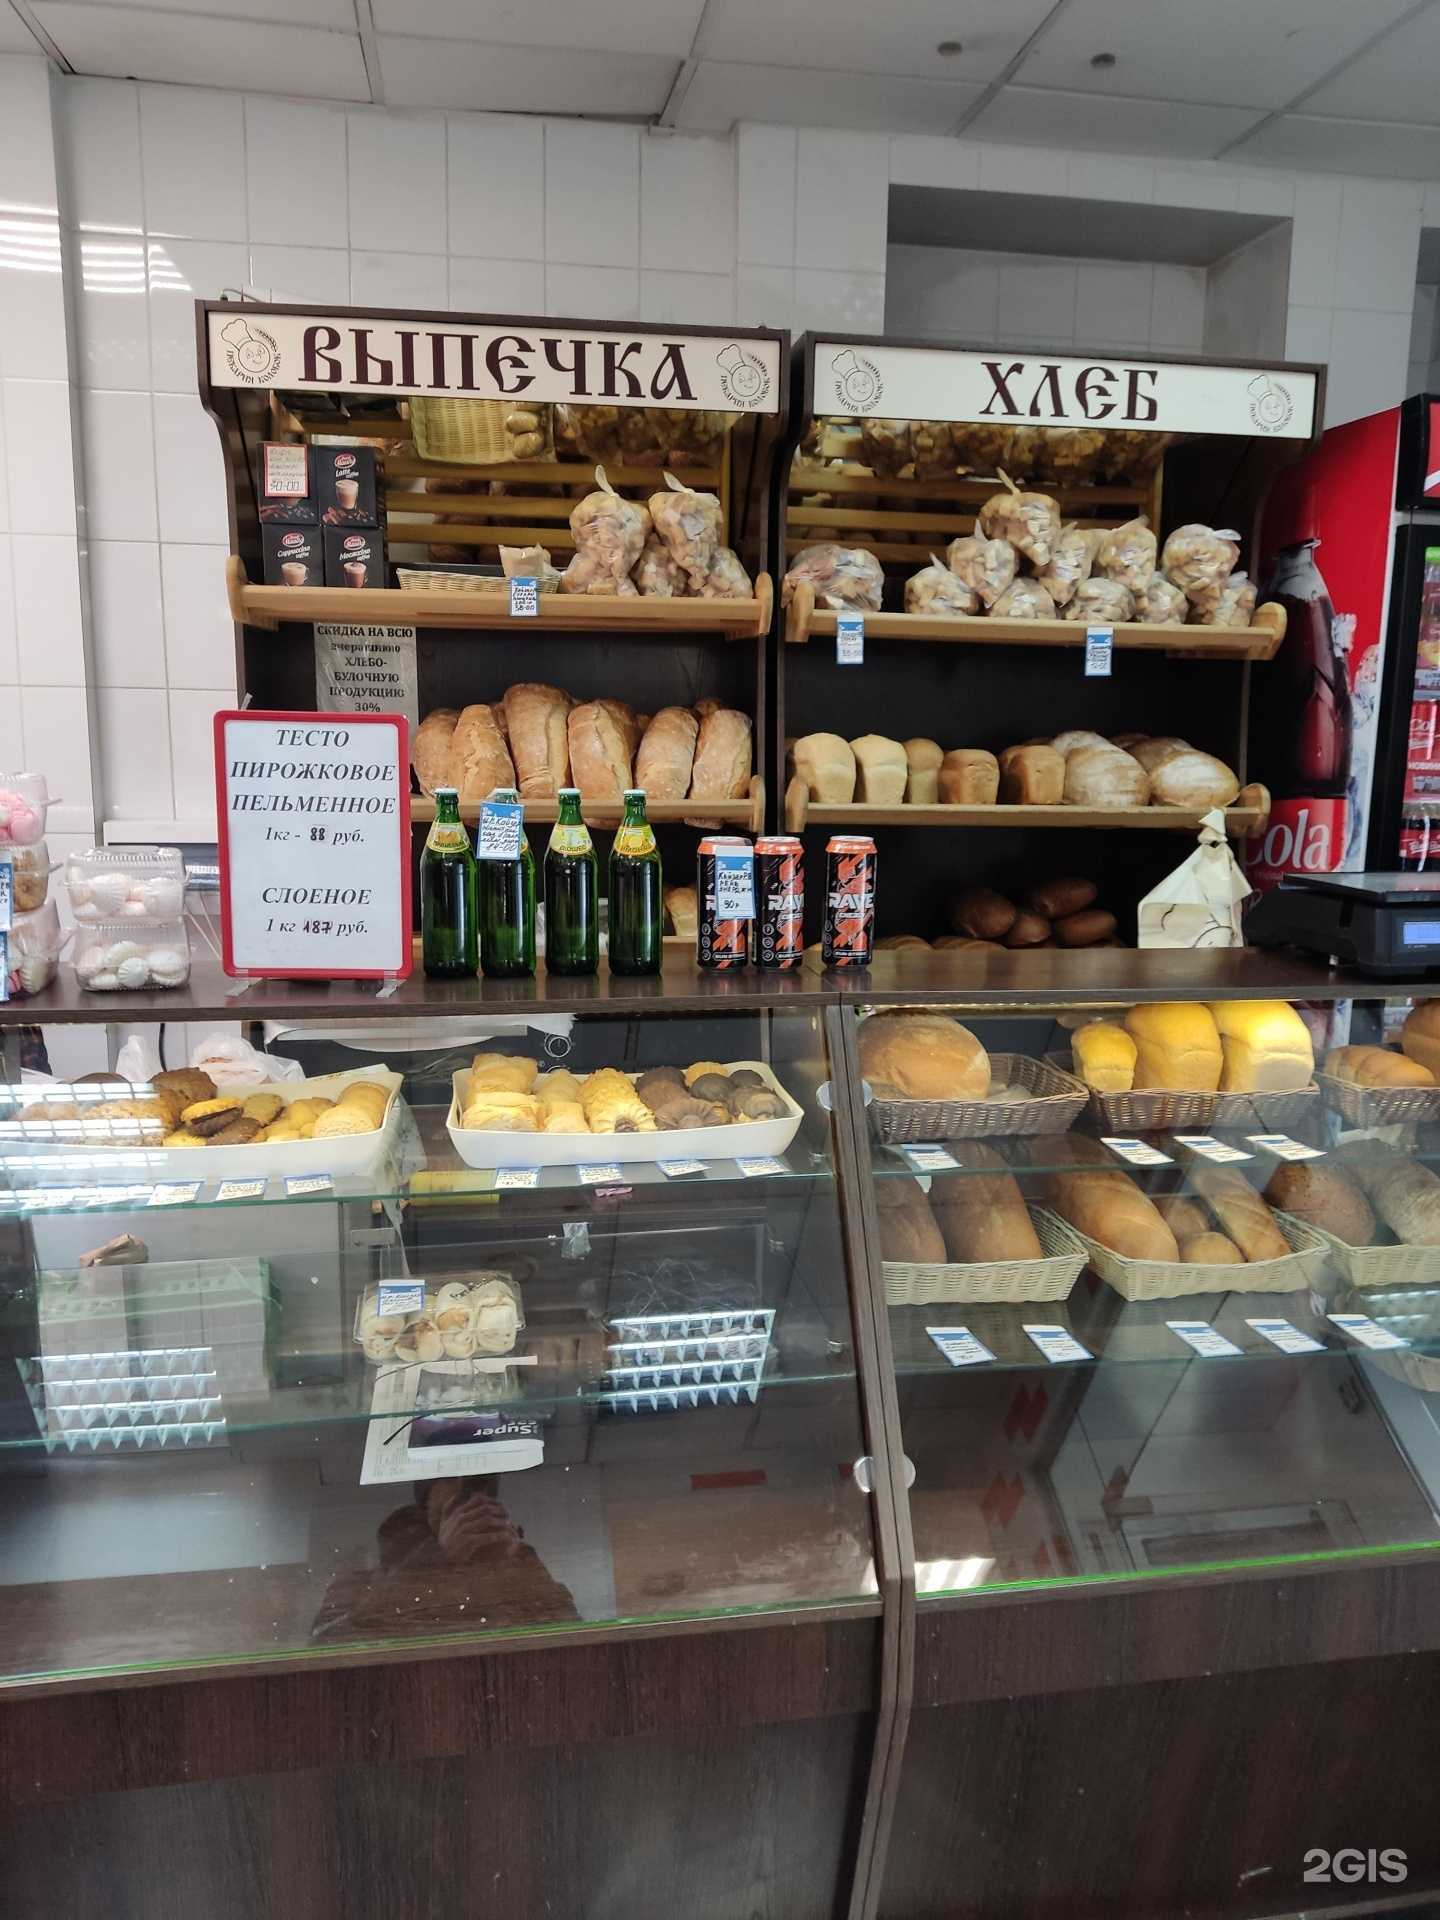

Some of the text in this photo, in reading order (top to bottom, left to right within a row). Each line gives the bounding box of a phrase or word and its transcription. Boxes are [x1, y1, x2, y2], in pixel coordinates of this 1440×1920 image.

[298, 325, 698, 400] ВЫПЕЧКА
[978, 362, 1159, 421] ХЛЕБ
[317, 625, 413, 638] СКИДКА НА ВСЮ
[345, 657, 388, 667] ХЛЕБО-
[334, 671, 399, 683] БУЛОЧНУЮ
[329, 686, 405, 698] ПРОДУКЦИЮ
[354, 702, 381, 712] 30%
[275, 729, 350, 748] ТЕСТО
[230, 761, 397, 781] ПИРОЖКОВОЕ
[231, 793, 397, 814] ПЕЛЬМЕННОЕ
[310, 827, 326, 842] 88
[332, 828, 365, 845] руб.
[262, 887, 372, 905] СЛОЕНОЕ
[767, 894, 805, 911] RAV
[828, 892, 875, 909] RAVE
[265, 918, 368, 937] 1 кг 187 руб.
[473, 1423, 532, 1437] Super
